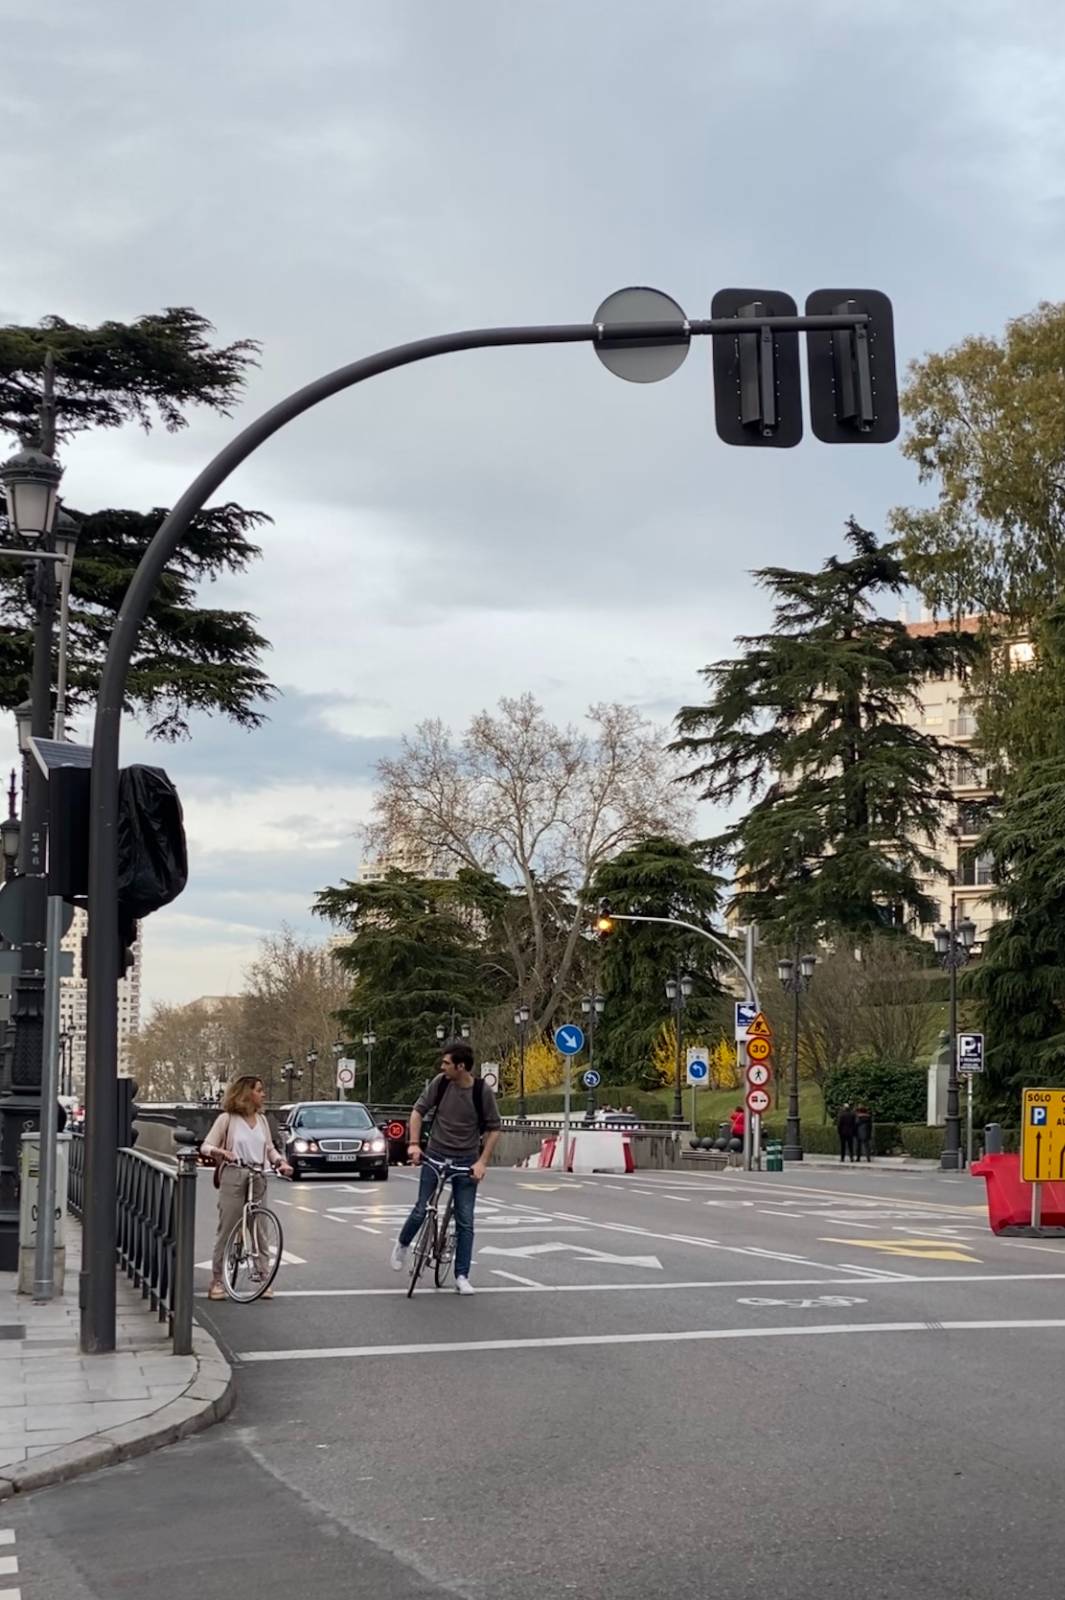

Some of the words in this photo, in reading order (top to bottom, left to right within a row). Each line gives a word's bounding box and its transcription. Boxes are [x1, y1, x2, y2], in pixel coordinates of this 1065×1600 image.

[752, 1044, 767, 1053] 30
[961, 1037, 976, 1056] P
[1028, 1093, 1051, 1102] SÓLO
[1034, 1107, 1045, 1124] P
